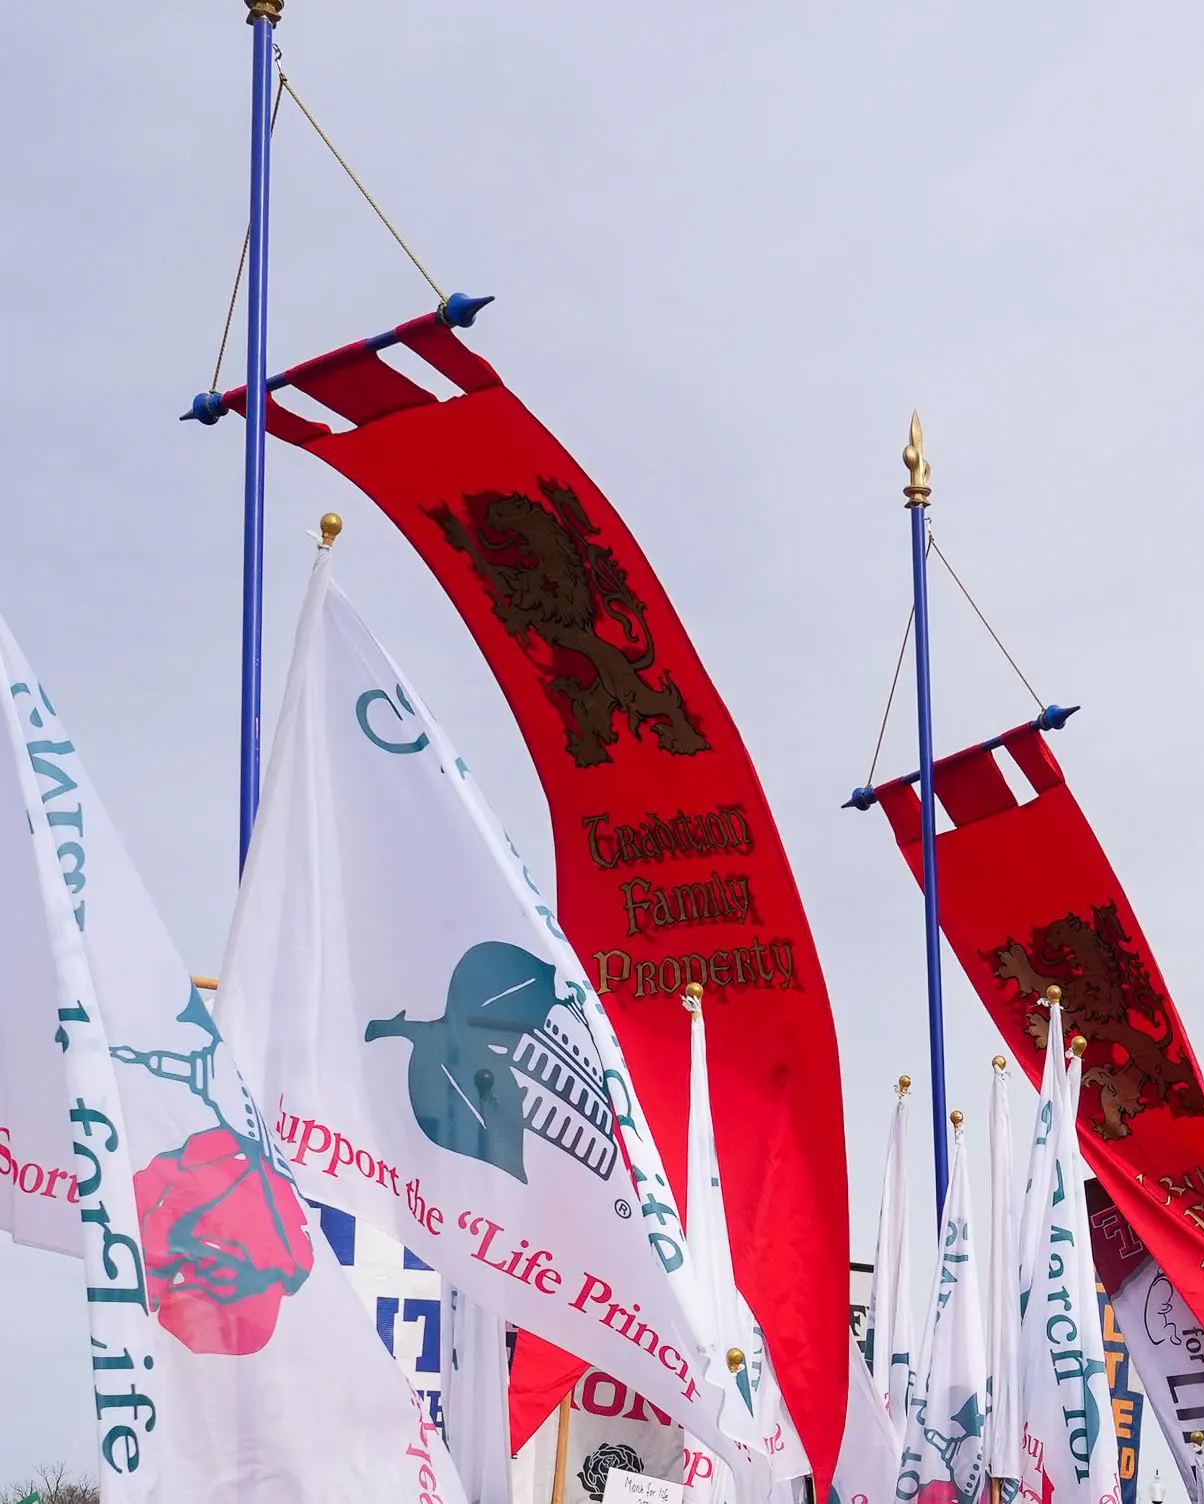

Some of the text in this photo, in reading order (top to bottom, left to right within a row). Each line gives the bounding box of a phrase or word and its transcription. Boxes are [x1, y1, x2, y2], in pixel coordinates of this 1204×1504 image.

[582, 808, 753, 869] Tradition
[620, 872, 750, 937] Family
[276, 1092, 400, 1197] upport
[406, 1178, 445, 1236] the
